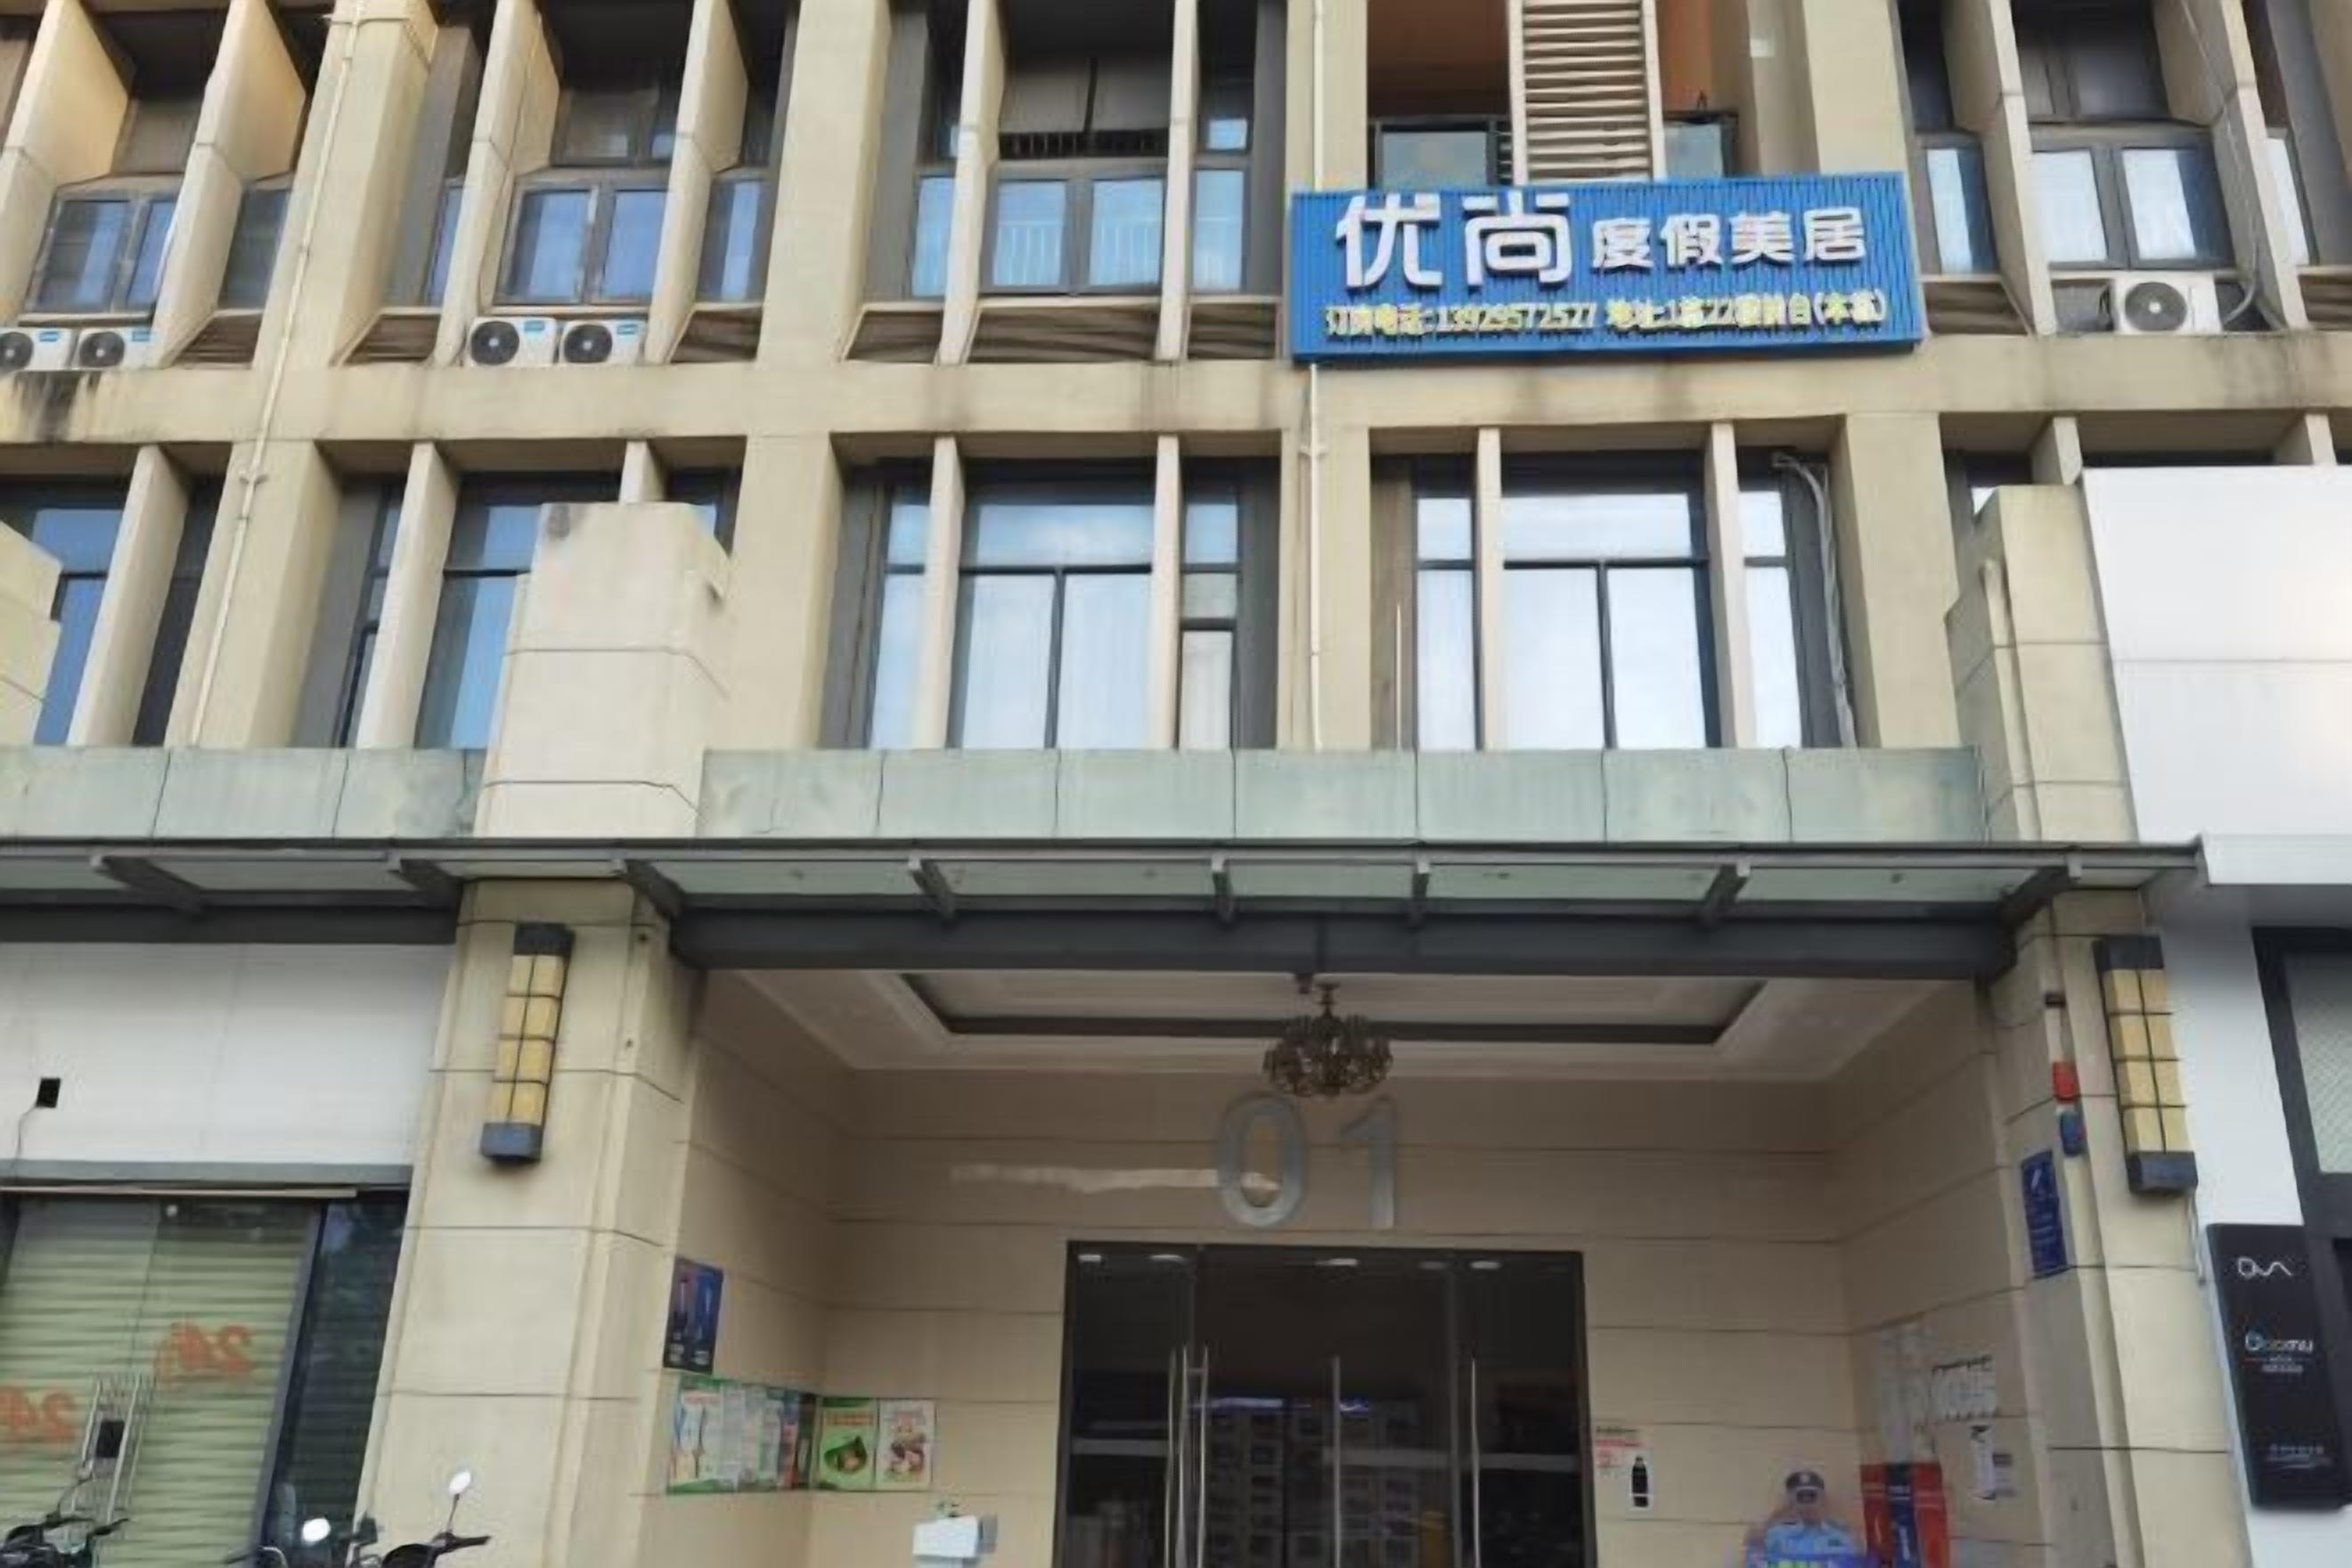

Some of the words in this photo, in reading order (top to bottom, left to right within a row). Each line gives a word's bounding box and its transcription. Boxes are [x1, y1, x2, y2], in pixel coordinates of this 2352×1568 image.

[1335, 190, 1572, 287] 优尚
[1592, 207, 1866, 268] 度假美居
[1217, 1092, 1398, 1228] 01
